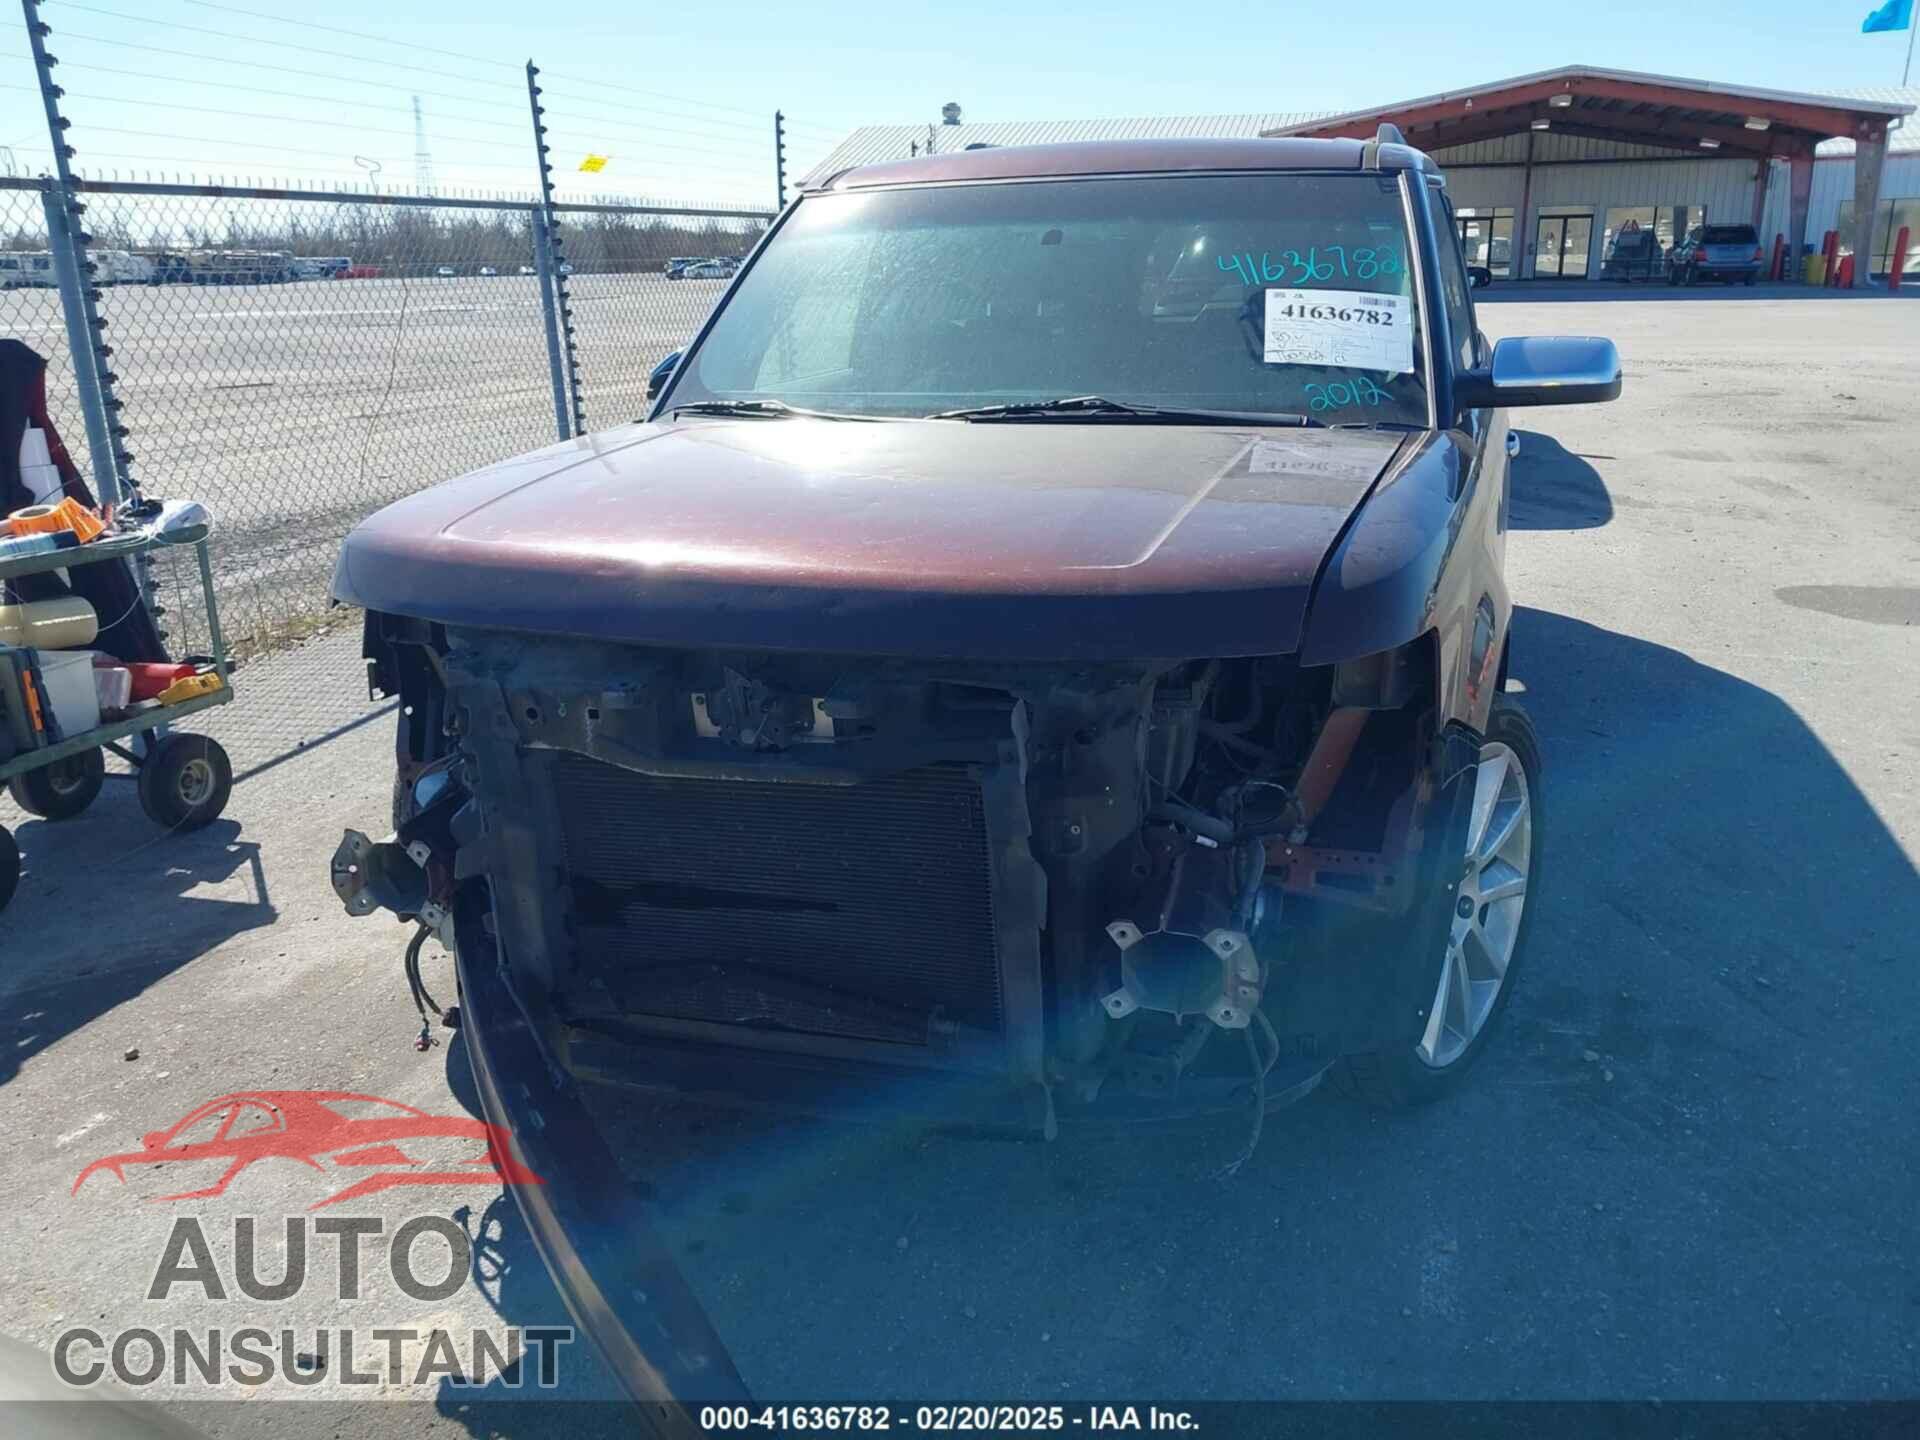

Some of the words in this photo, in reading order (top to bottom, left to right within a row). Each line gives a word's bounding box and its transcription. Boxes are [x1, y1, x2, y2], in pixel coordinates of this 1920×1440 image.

[1216, 246, 1407, 286] 41636782
[1281, 303, 1394, 327] 41636782
[1304, 376, 1393, 411] 2012
